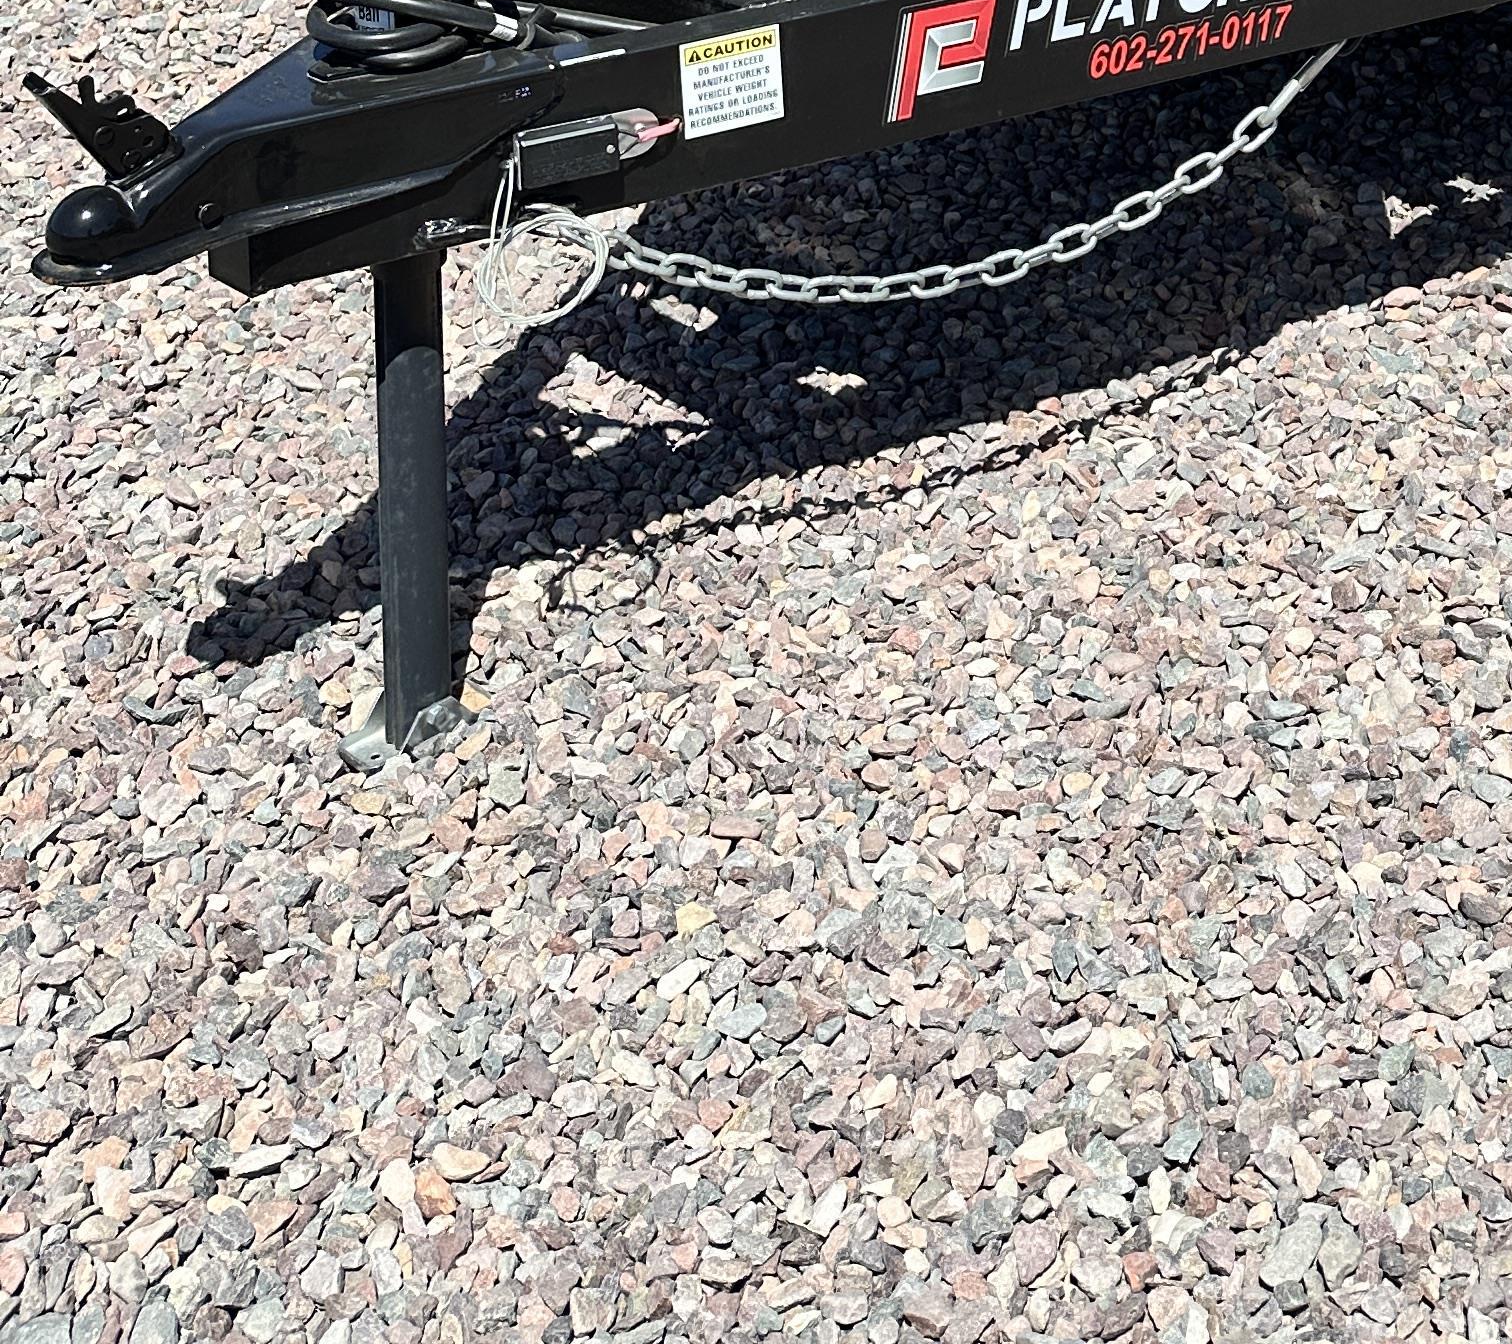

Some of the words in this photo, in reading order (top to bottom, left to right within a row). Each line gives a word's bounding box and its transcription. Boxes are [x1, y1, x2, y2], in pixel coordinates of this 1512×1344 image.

[703, 34, 773, 58] CAUTION
[1090, 4, 1293, 79] 602-271-0117
[698, 67, 709, 76] DO
[713, 62, 729, 72] NOT
[733, 54, 764, 69] EXCEED
[694, 66, 770, 90] MANUFACTURER'S
[698, 87, 732, 101] VEHICLE
[735, 79, 767, 93] WEIGHT
[689, 102, 724, 116] RATINGS
[742, 89, 778, 104] LOADING
